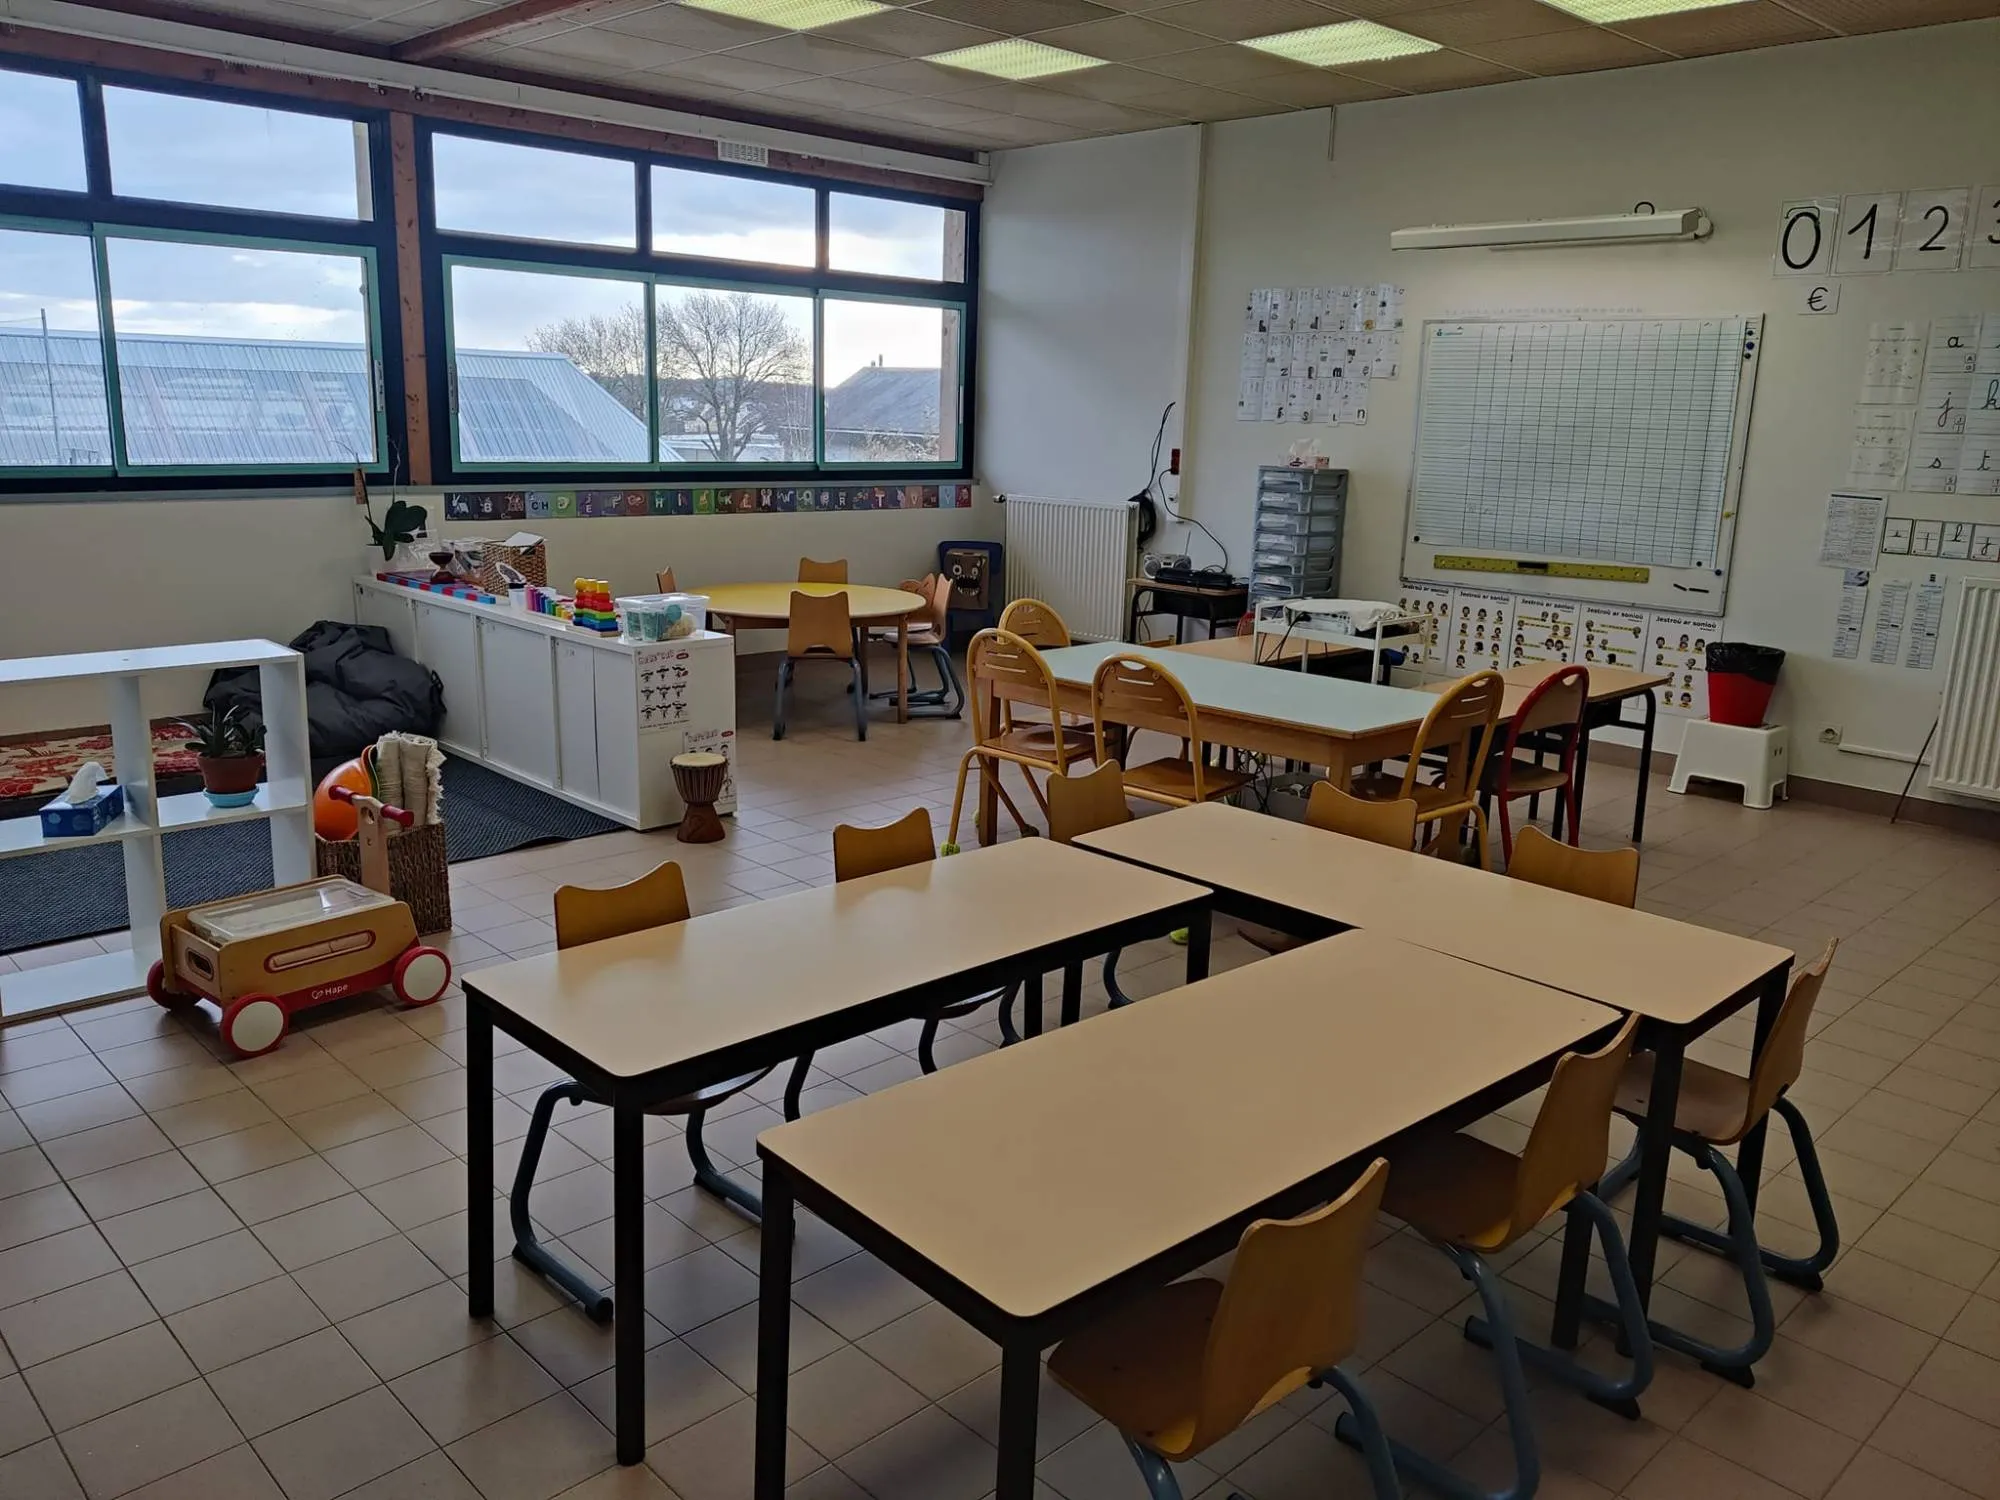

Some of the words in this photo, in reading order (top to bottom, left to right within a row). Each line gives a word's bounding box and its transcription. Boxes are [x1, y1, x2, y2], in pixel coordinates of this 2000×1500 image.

[1782, 212, 1821, 270] 0
[1847, 203, 1878, 260] 1
[1919, 205, 1949, 251] 2
[1807, 287, 1828, 311] €
[1947, 336, 1964, 348] a
[1937, 391, 1953, 427] j
[1928, 457, 1942, 469] s
[1977, 449, 1991, 471] t
[325, 984, 348, 996] Hape
